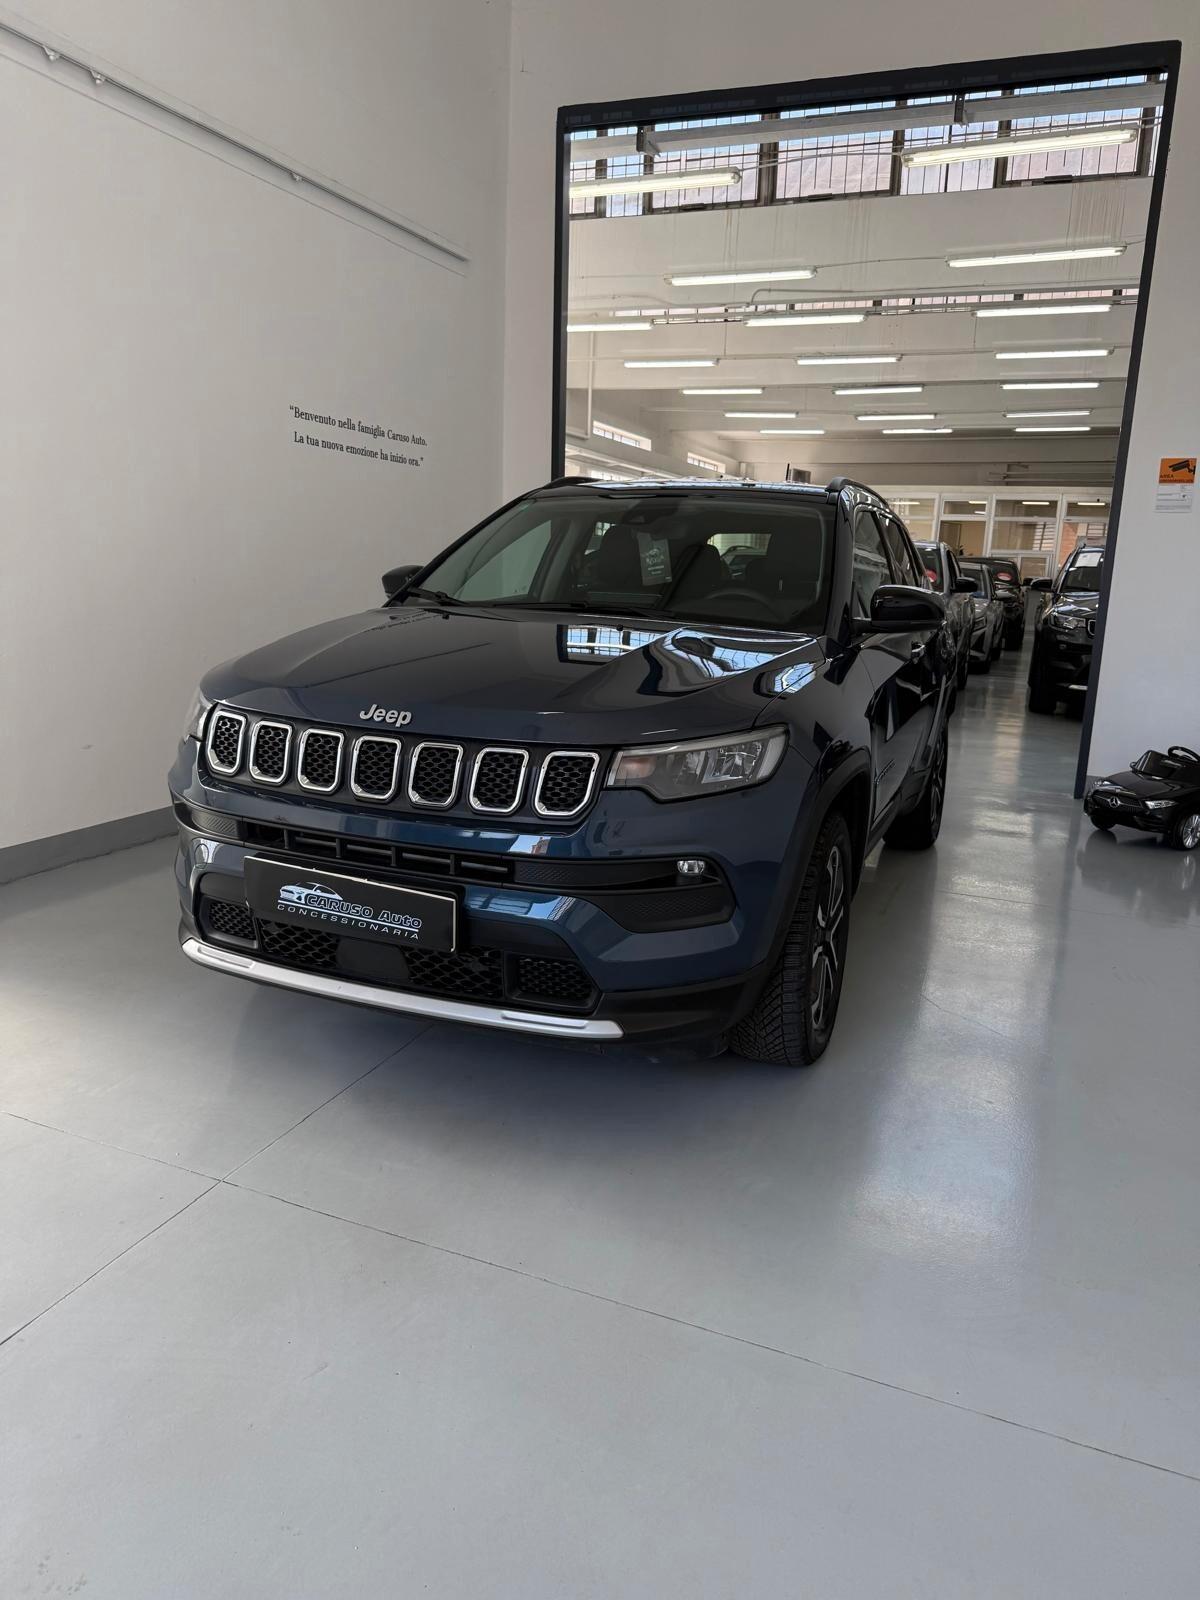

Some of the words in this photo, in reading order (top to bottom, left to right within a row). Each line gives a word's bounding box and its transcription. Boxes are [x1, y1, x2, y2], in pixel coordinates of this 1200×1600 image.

[294, 431, 305, 444] La
[306, 435, 320, 447] tua
[321, 440, 344, 452] nuova
[345, 446, 379, 459] emozione
[380, 449, 389, 461] ha
[390, 452, 407, 464] inizio
[338, 418, 356, 431] nella
[357, 421, 385, 439] famiglia
[387, 429, 410, 443] Caruso
[410, 435, 428, 447] Auto.
[359, 704, 412, 728] Jeep
[277, 904, 420, 940] CONCESSIONARIA
[306, 894, 374, 918] CARUSO
[378, 910, 423, 929] Auto
